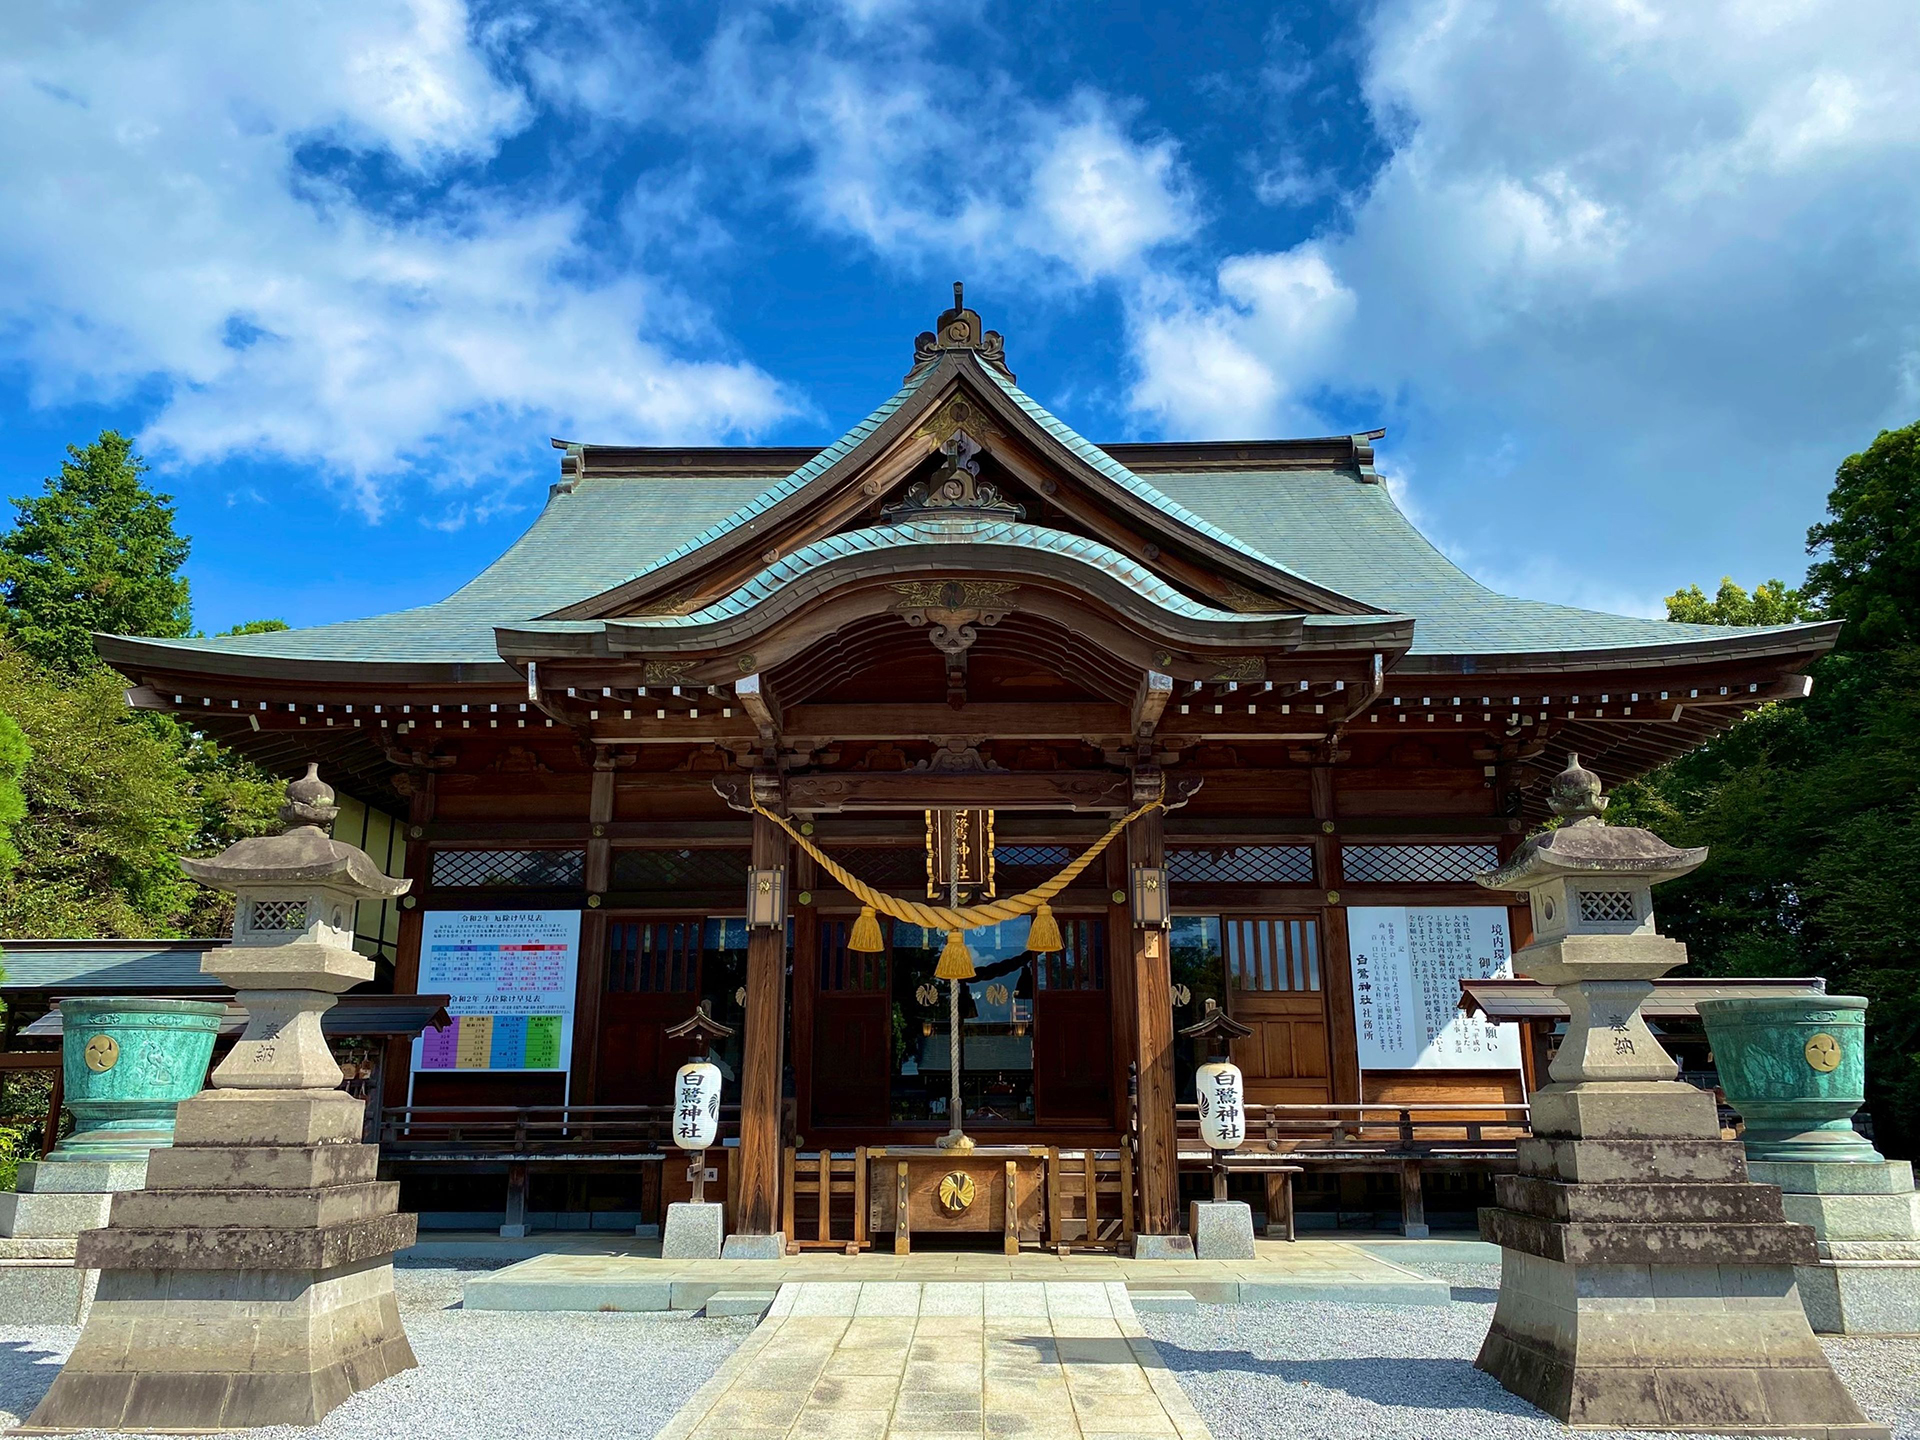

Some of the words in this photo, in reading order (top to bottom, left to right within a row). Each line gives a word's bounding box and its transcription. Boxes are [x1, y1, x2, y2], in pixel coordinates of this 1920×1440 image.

[461, 914, 490, 922] 令和2年
[494, 914, 543, 922] 厄除け早見表
[451, 995, 479, 1003] 令和2年
[484, 995, 541, 1003] 方位除け早見表
[253, 1022, 280, 1063] 奉納
[1608, 1014, 1636, 1055] 奉納
[677, 1070, 705, 1139] 白鷺神社
[1213, 1070, 1241, 1140] 白鷺神社
